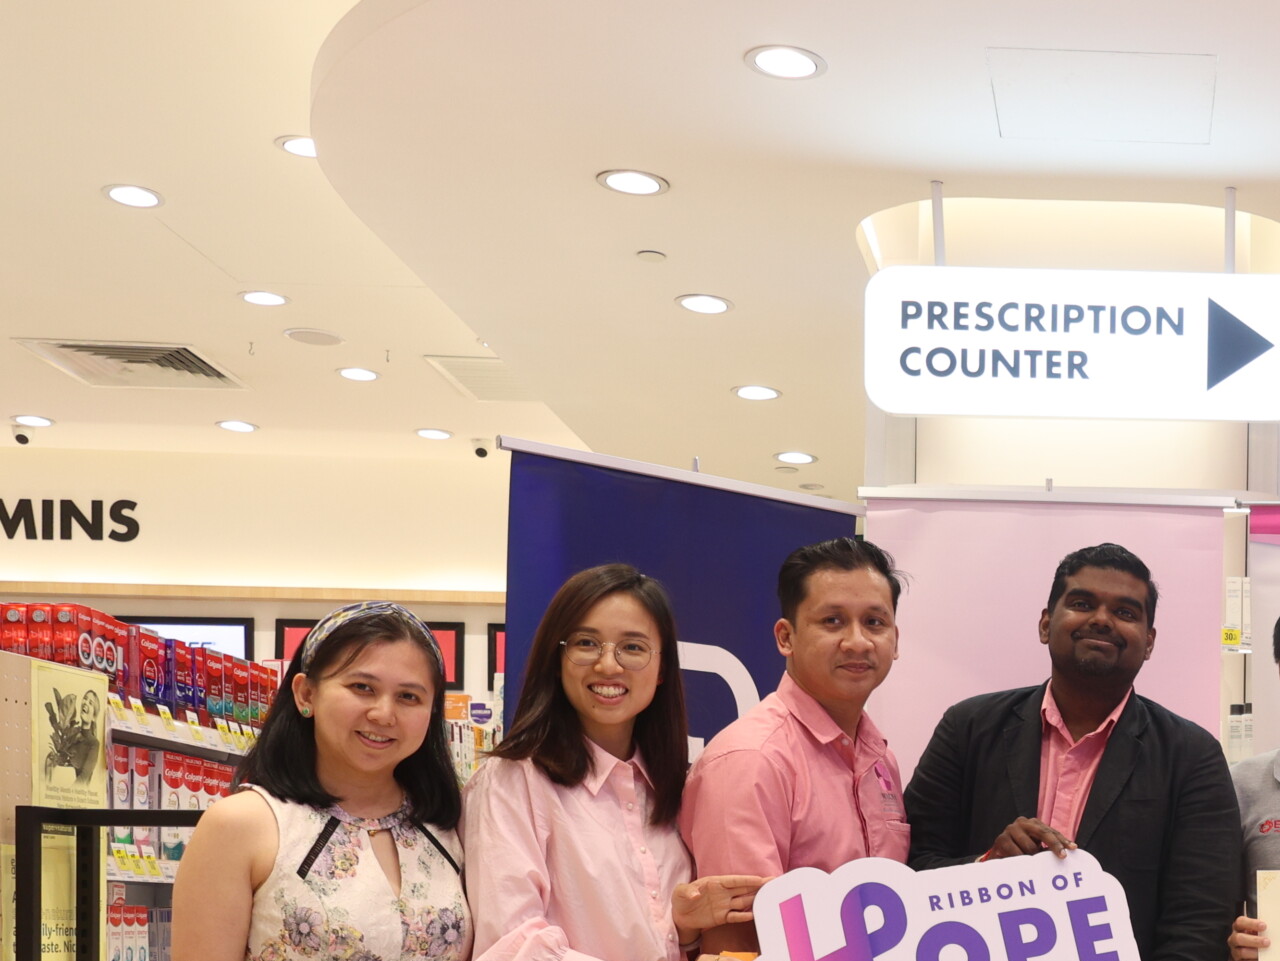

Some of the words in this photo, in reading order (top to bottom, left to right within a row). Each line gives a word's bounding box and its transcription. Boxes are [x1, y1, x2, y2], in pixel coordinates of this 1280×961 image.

[900, 300, 1185, 336] PRESCRIPTION
[899, 346, 1090, 380] COUNTER
[0, 498, 140, 541] MINS
[928, 879, 1036, 912] RIBBON
[1052, 872, 1083, 891] OF
